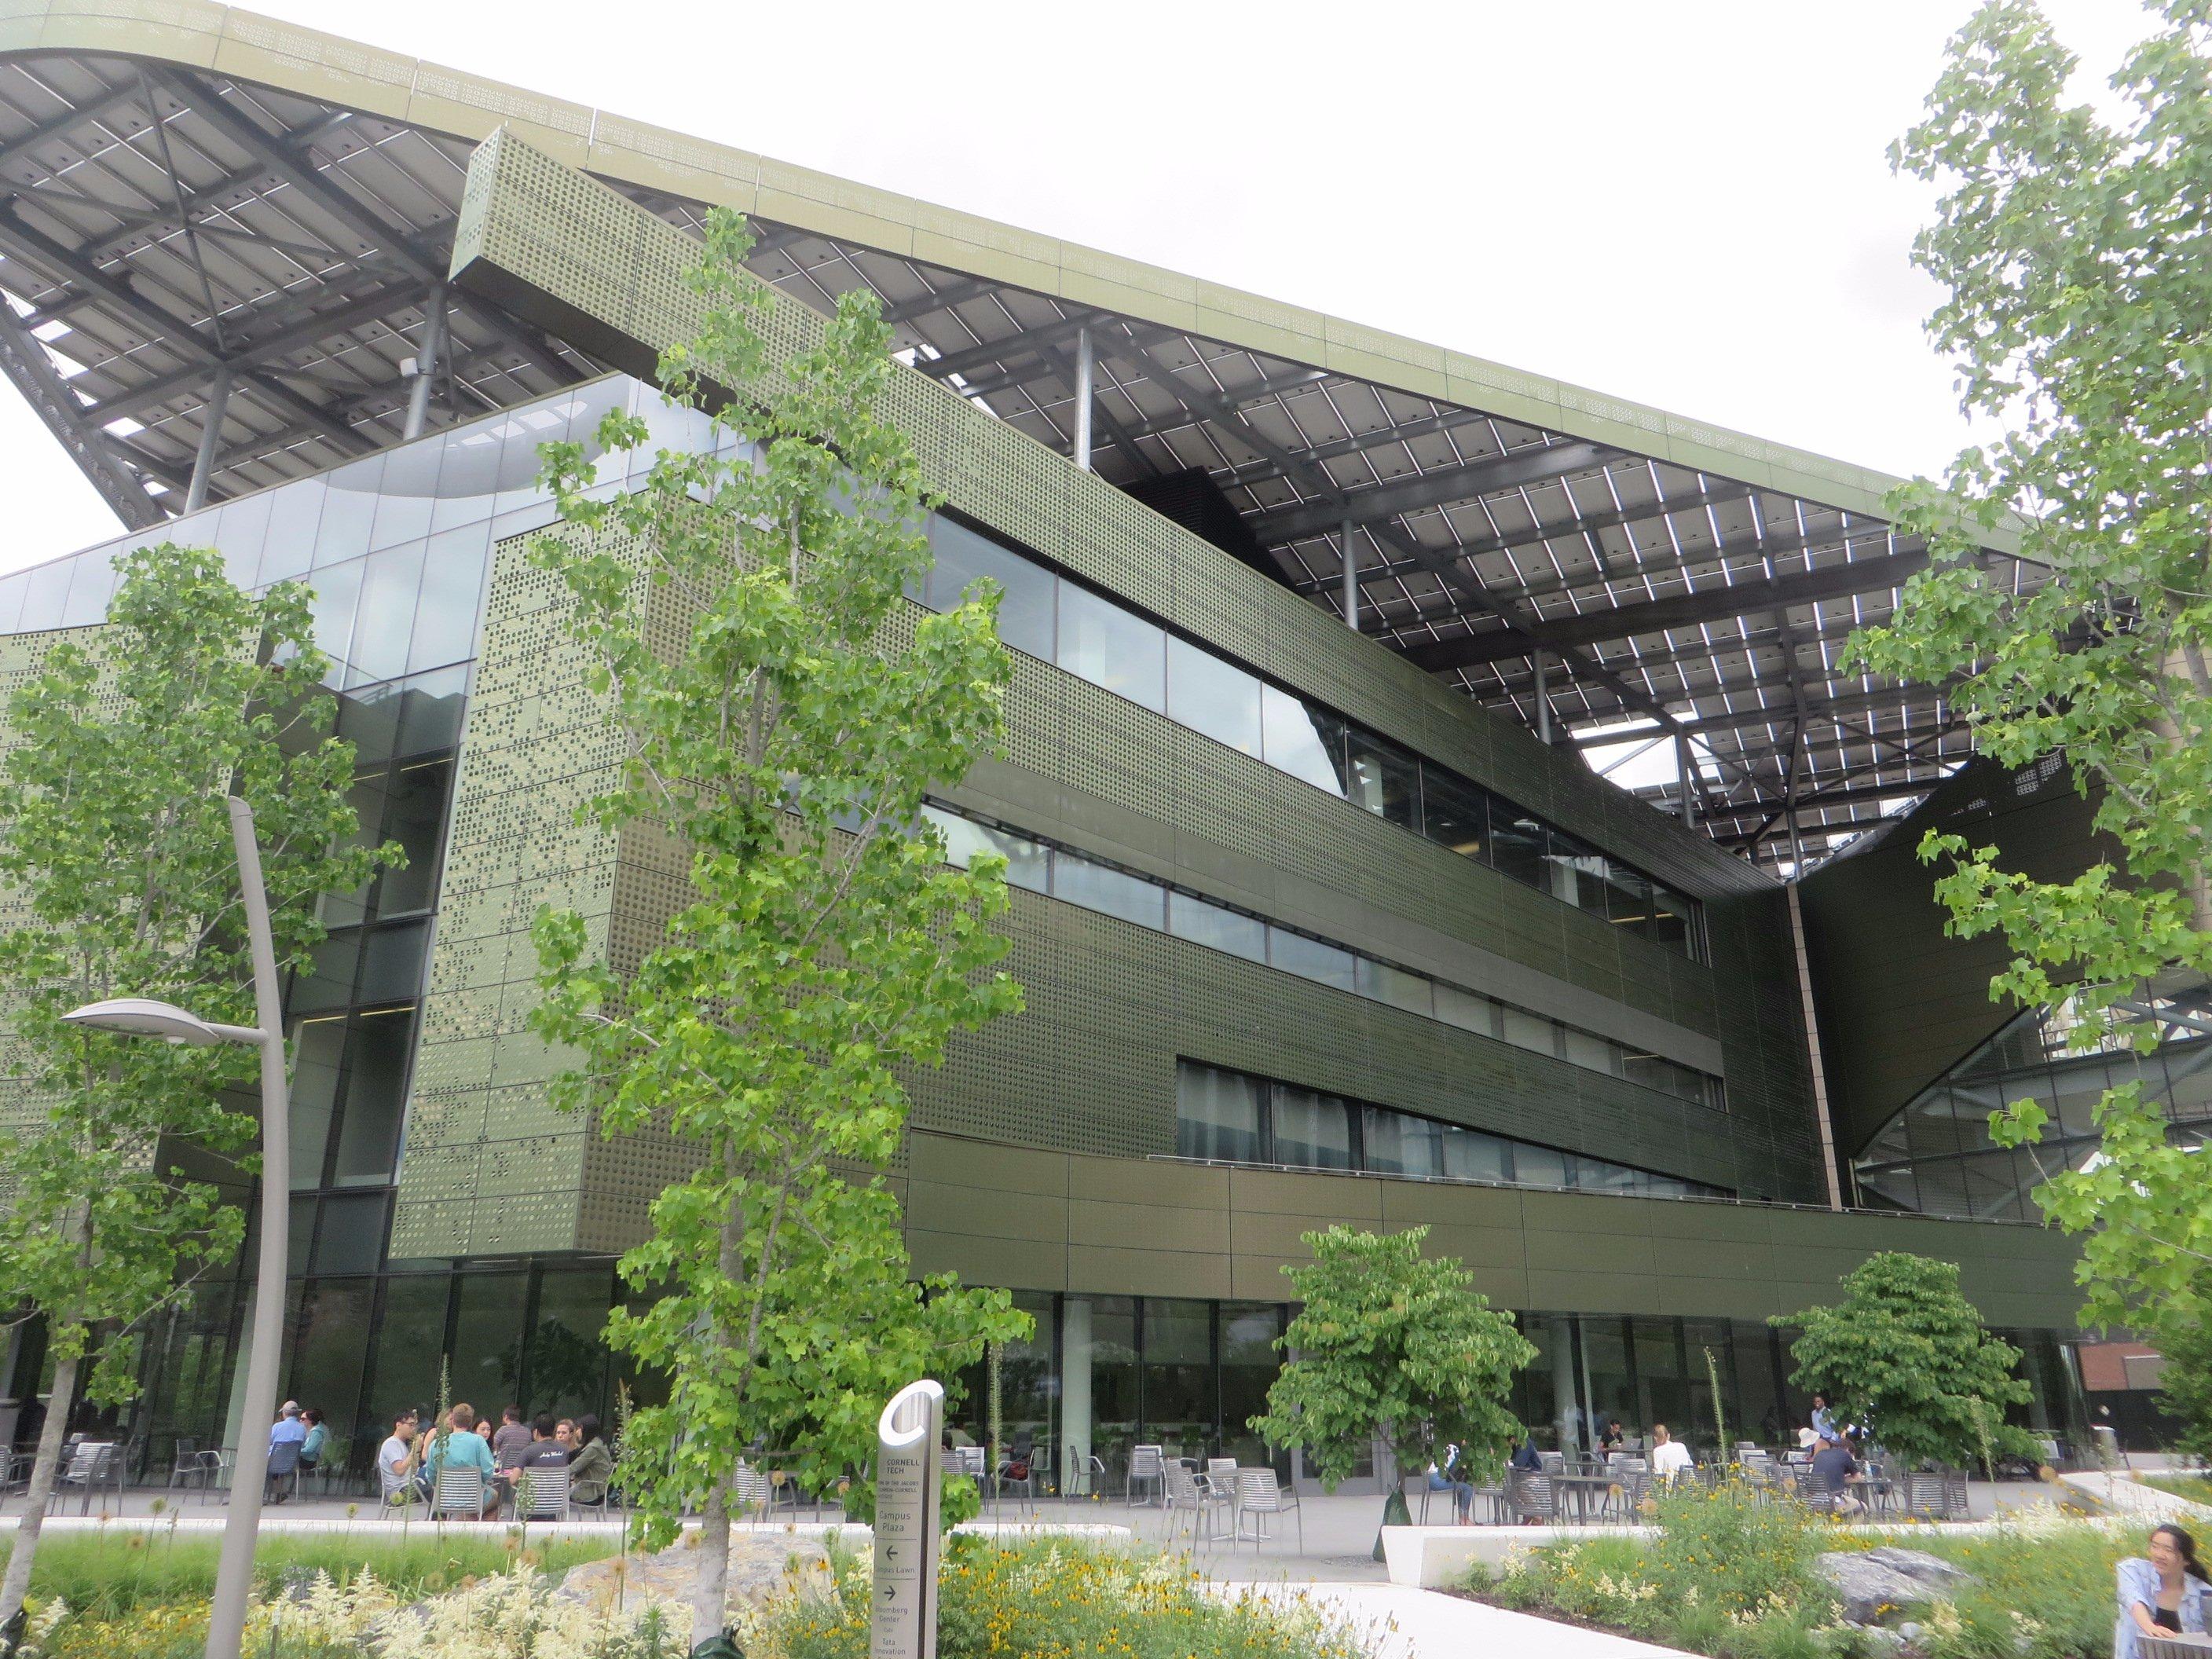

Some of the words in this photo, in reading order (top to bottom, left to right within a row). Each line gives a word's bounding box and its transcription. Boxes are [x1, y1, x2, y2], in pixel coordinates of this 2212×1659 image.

[887, 1458, 919, 1467] CORNELL
[880, 1511, 911, 1522] Campus
[882, 1522, 904, 1532] Plaza
